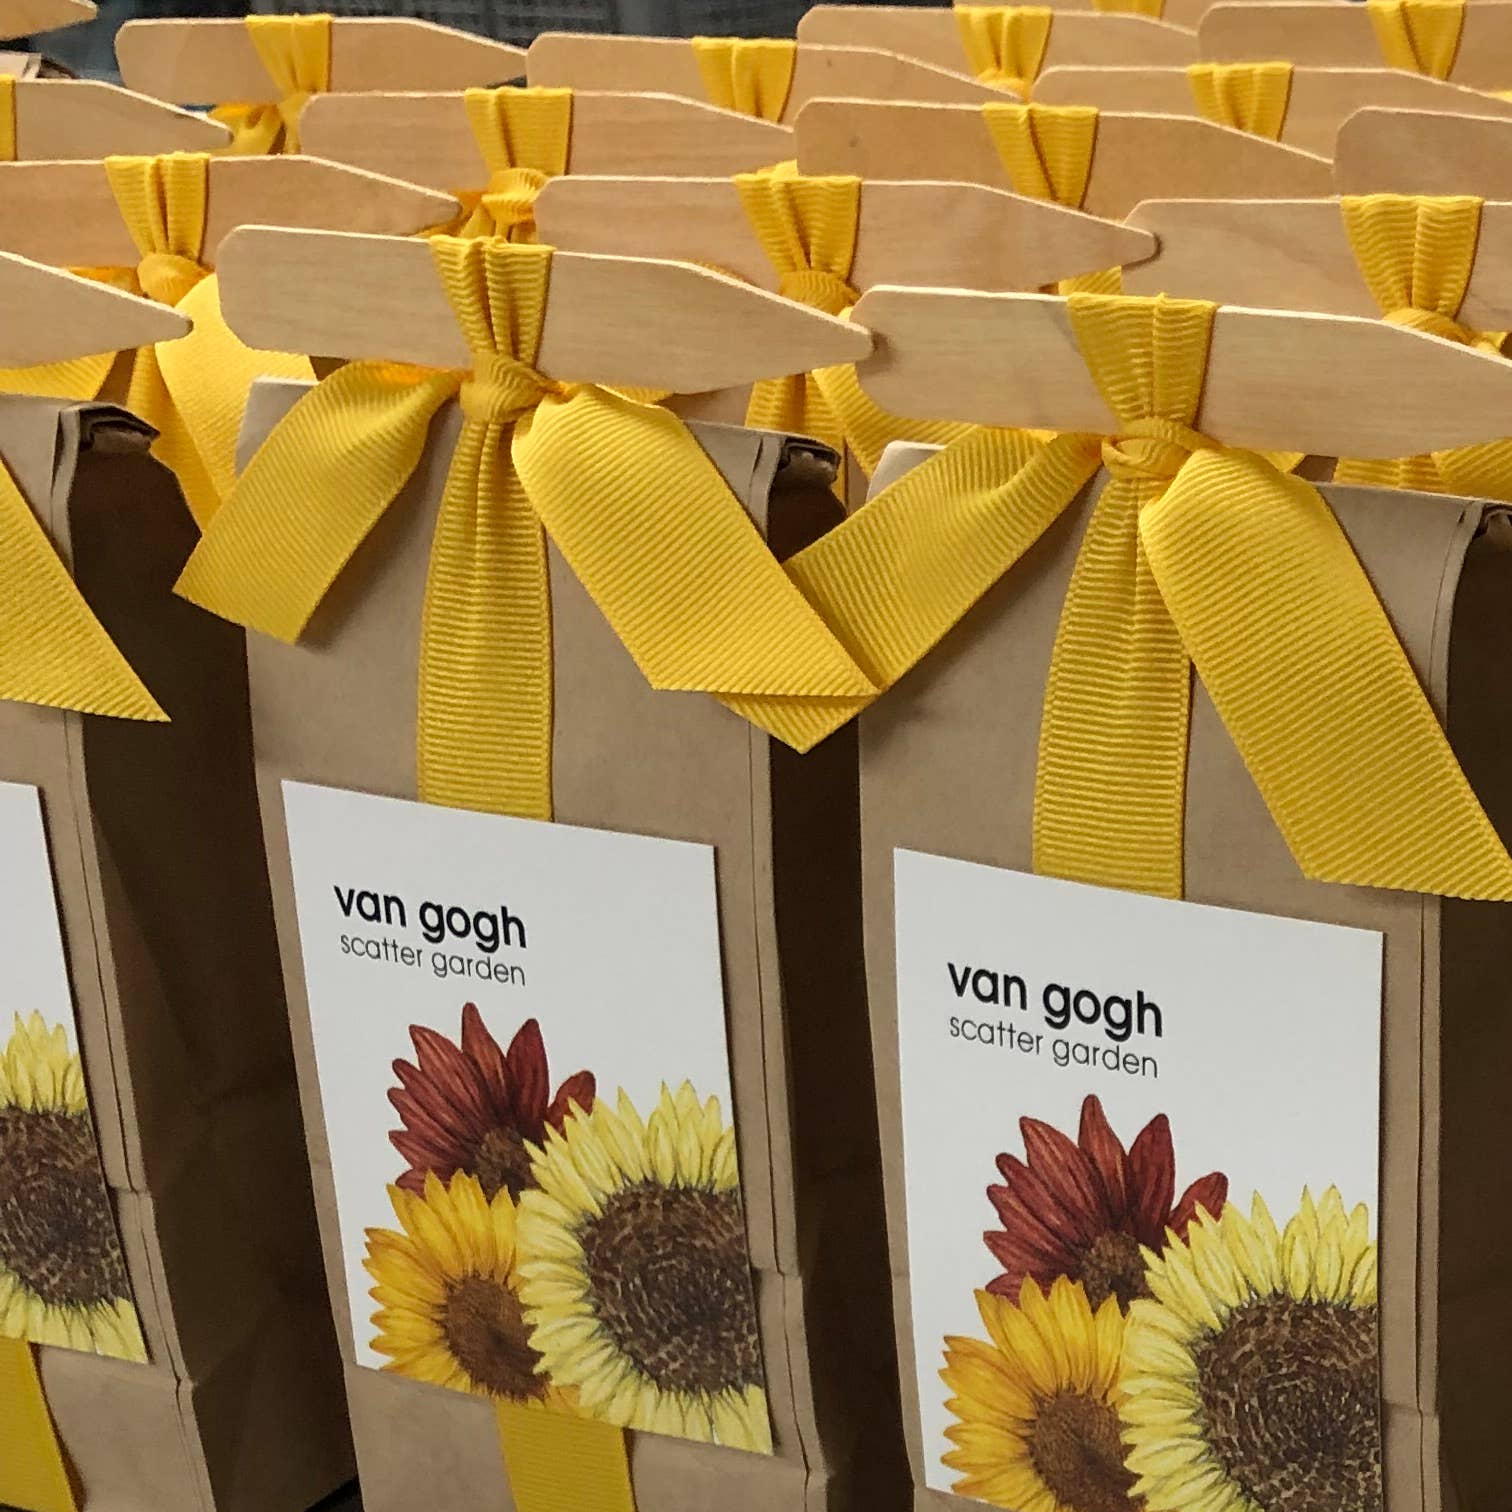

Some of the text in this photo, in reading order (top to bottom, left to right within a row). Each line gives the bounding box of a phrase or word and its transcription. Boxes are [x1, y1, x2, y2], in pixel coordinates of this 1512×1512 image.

[333, 885, 528, 954] van gogh
[340, 933, 526, 987] scatter garden
[946, 962, 1163, 1044] van gogh
[949, 1015, 1158, 1080] scatter garden
